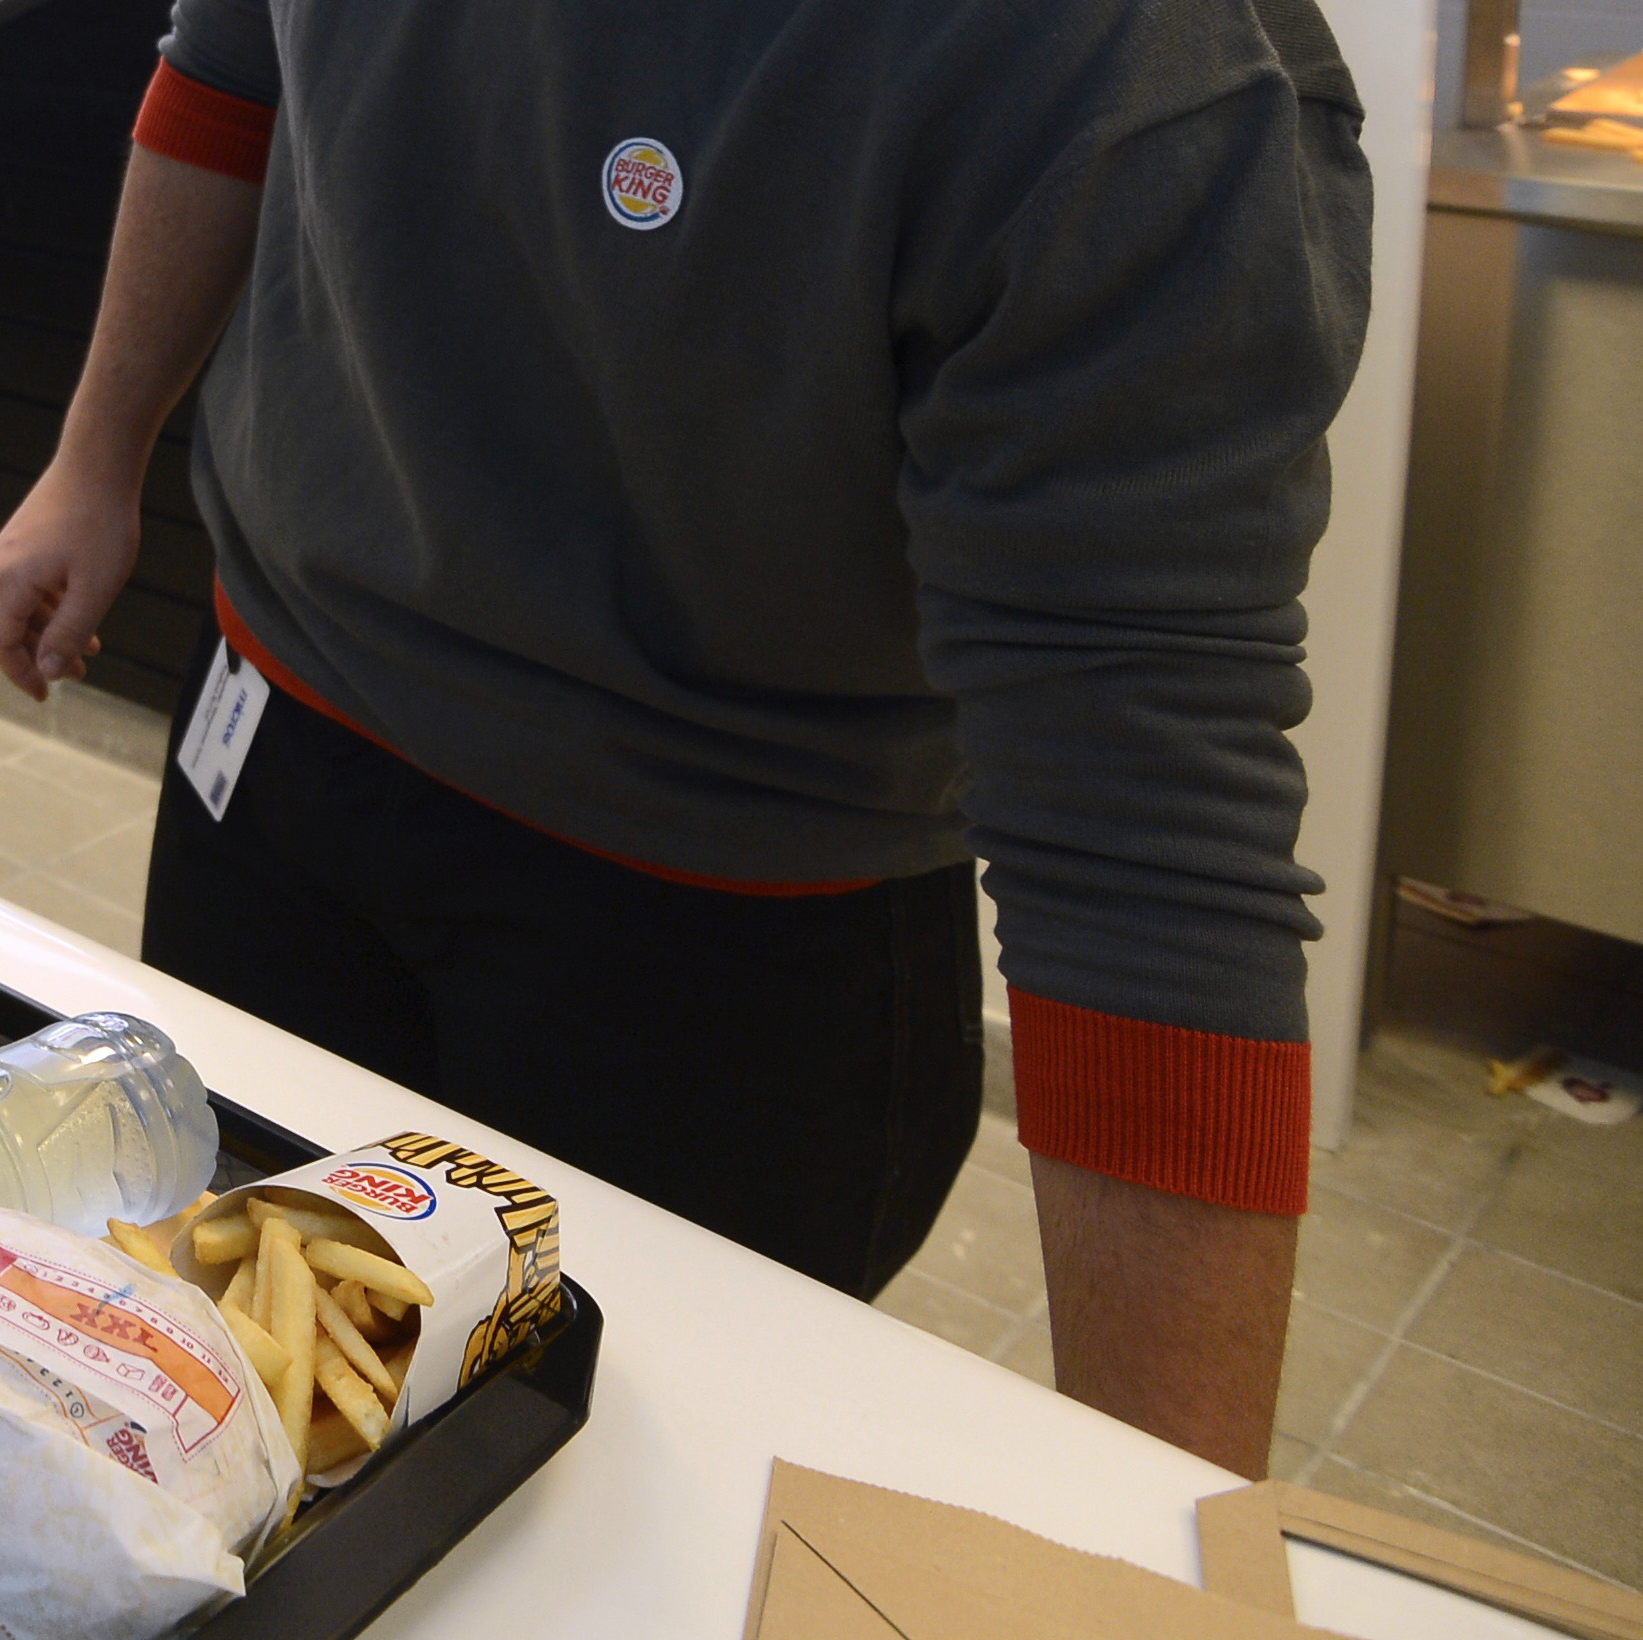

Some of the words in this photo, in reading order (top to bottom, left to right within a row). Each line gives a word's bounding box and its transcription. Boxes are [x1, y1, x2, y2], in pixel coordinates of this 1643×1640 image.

[611, 173, 671, 204] KING
[615, 158, 674, 187] BURGER
[322, 1176, 419, 1215] BURGER
[330, 1168, 435, 1206] KING
[67, 1302, 159, 1353] XXL
